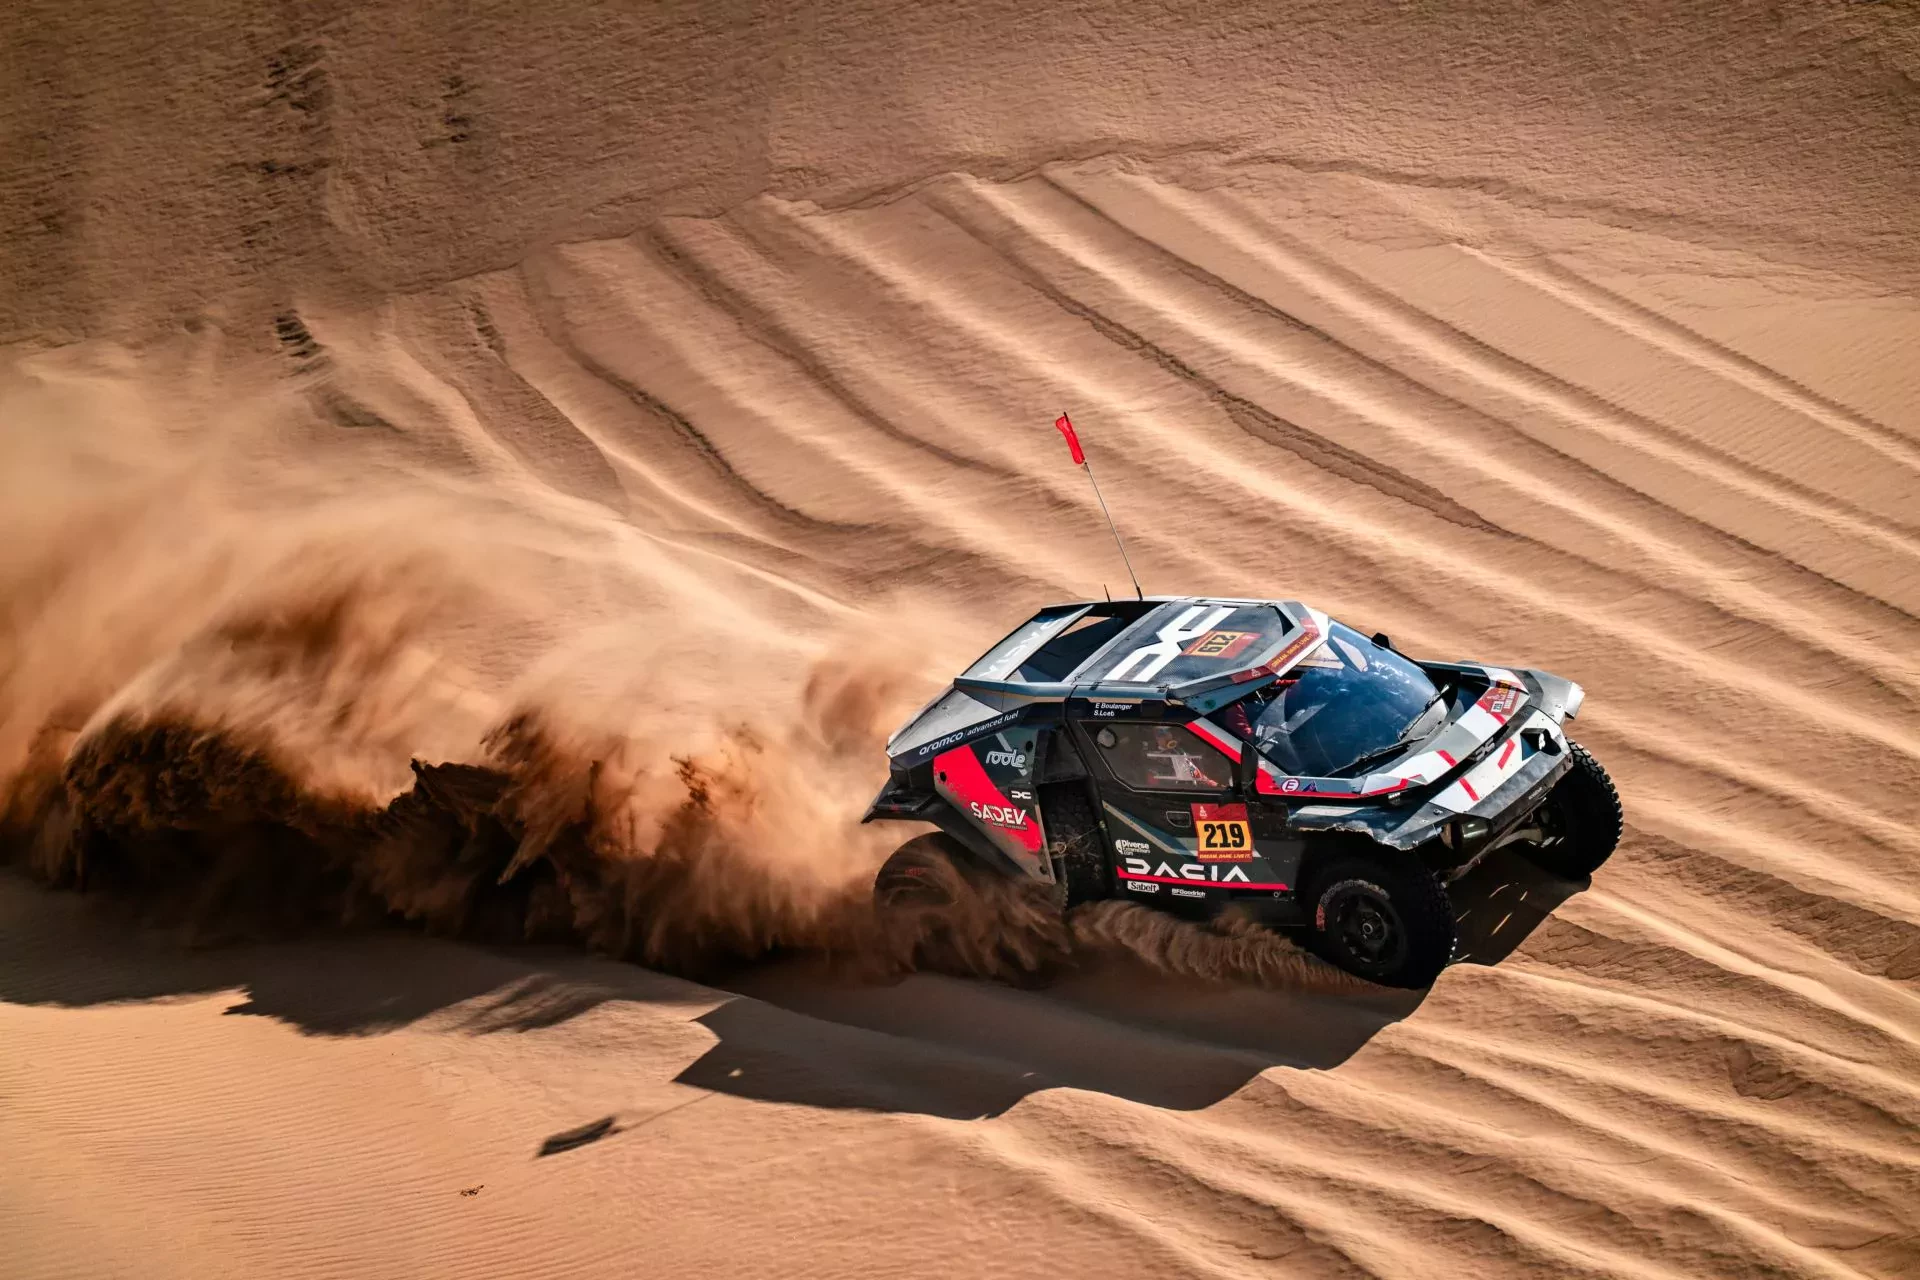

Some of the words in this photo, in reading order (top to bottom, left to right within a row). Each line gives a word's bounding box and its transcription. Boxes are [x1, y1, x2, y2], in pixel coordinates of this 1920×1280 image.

[1197, 633, 1238, 652] 219
[1101, 702, 1132, 710] Boulanger
[919, 731, 964, 756] aramco
[967, 716, 1003, 736] advanced
[1004, 710, 1019, 722] fuel
[985, 748, 1026, 769] roole
[1121, 839, 1150, 849] Diverse
[1204, 823, 1245, 848] 219
[1125, 858, 1250, 882] DACIA
[1131, 881, 1157, 892] Sabelt
[1171, 887, 1206, 897] BFGoodrich
